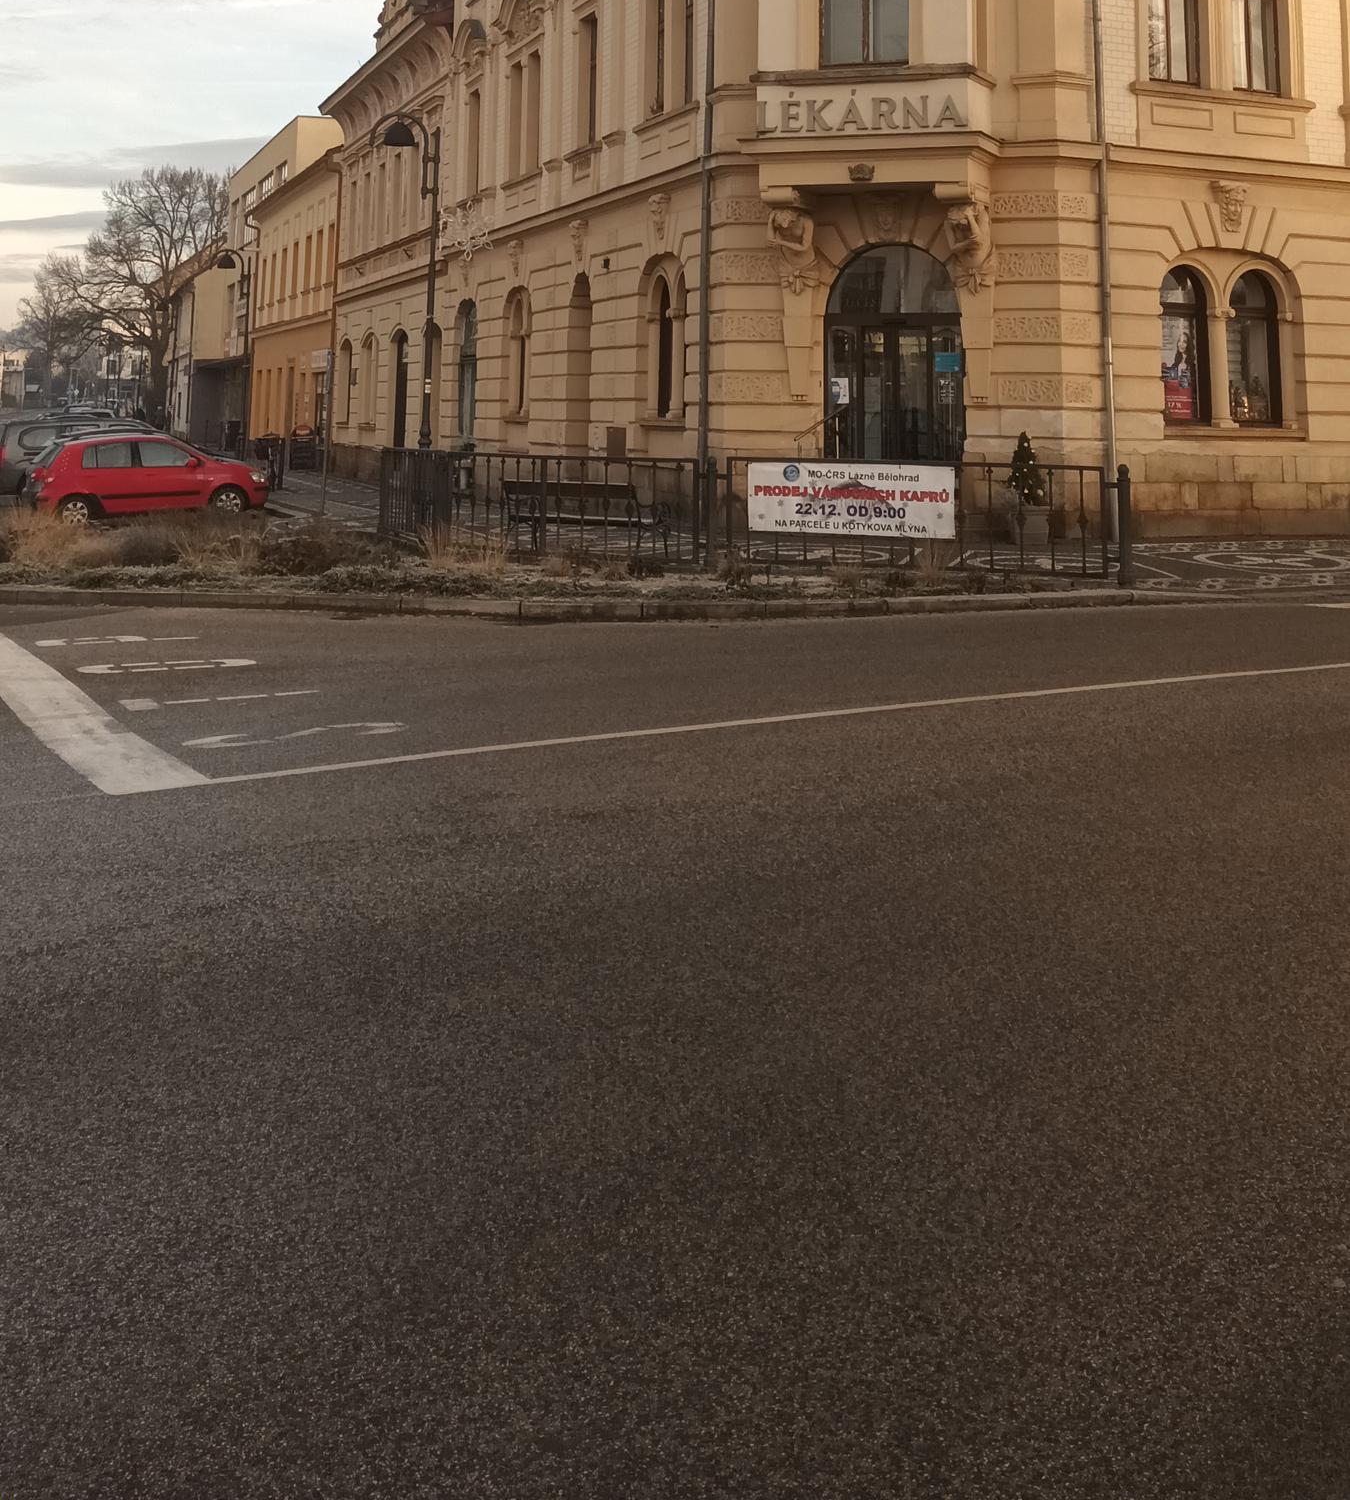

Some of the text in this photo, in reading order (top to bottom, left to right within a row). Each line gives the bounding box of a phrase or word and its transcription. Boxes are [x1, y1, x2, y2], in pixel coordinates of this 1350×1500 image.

[757, 89, 968, 133] LÉKÁRNA
[807, 469, 846, 480] MO-ČRS
[877, 472, 920, 482] Bělohrad
[754, 485, 808, 497] PRODEJ
[899, 488, 950, 503] KAPRŮ
[846, 505, 869, 517] OD
[873, 506, 906, 519] 9:00
[774, 519, 788, 527] NA
[789, 520, 830, 529] PARCELE
[833, 521, 839, 530] U
[842, 521, 892, 532] KOTYKOVA
